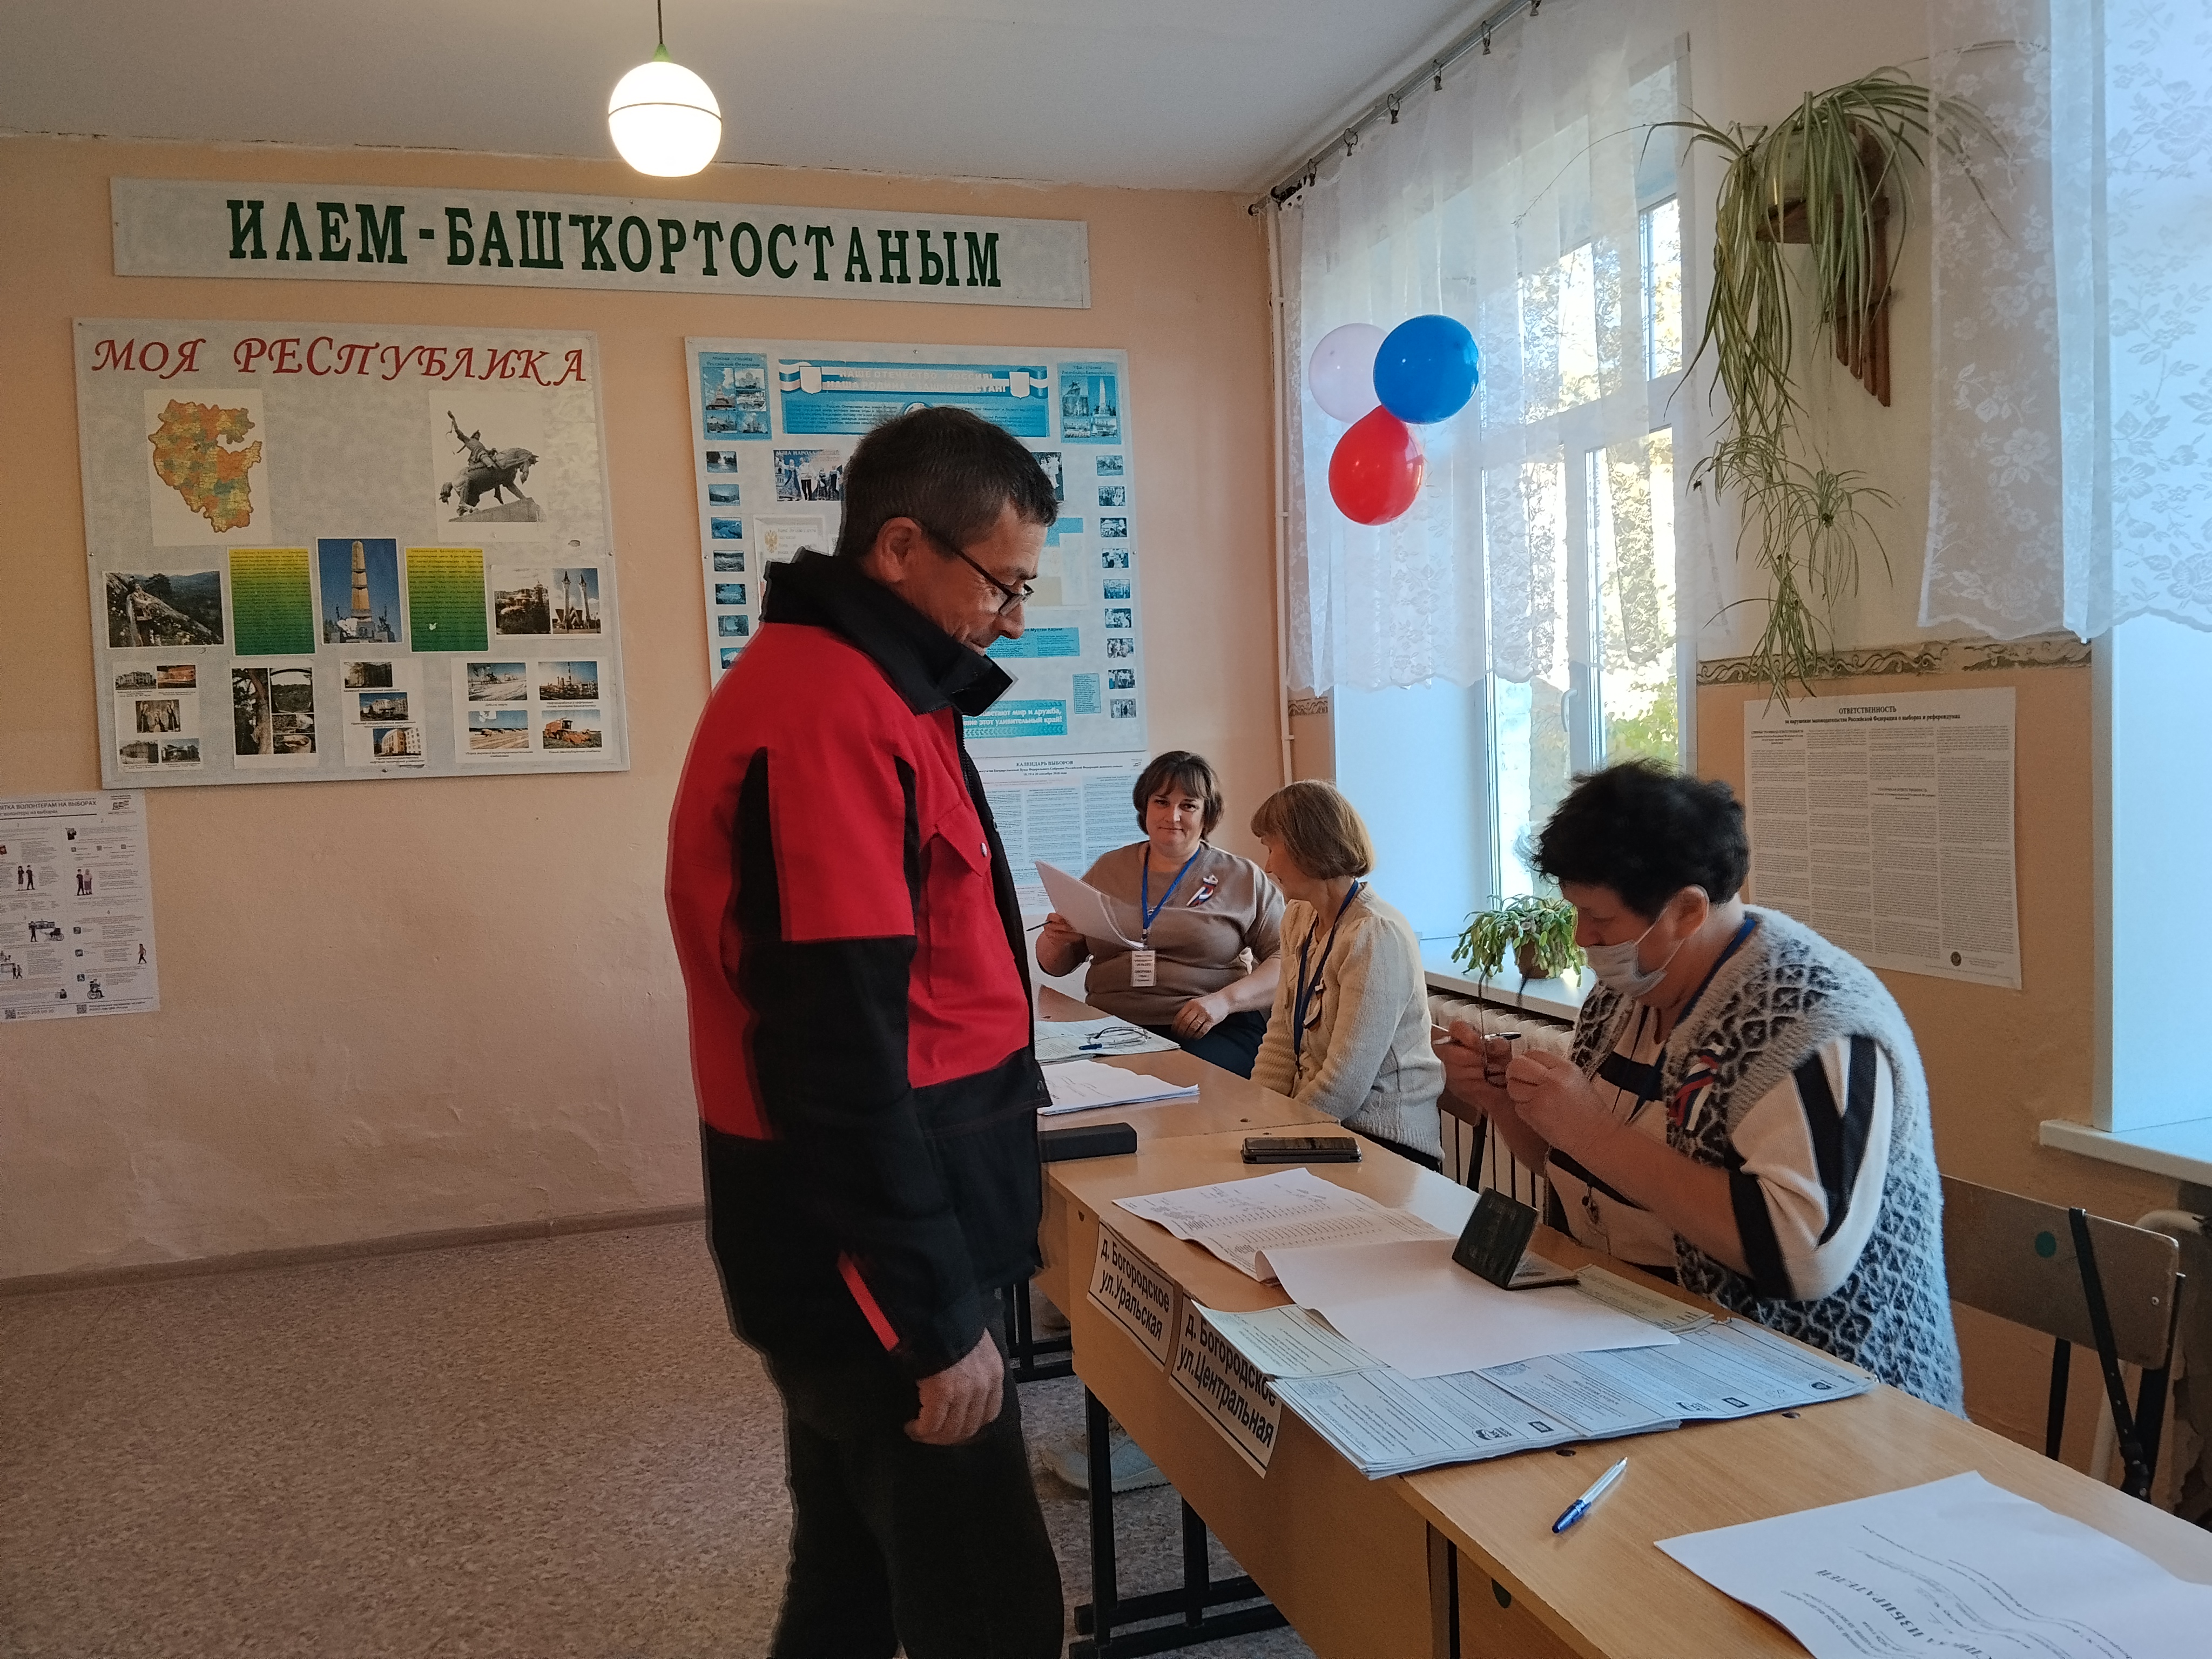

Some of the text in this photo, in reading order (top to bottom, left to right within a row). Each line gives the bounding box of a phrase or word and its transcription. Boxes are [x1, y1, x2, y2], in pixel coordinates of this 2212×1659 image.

[92, 336, 586, 386] МОЯ РЕСПУБЛИКА
[874, 371, 938, 379] ОТЕЧЕСТВО
[826, 380, 859, 390] НАША
[1012, 709, 1027, 717] мир
[1034, 707, 1062, 716] дружба,
[1839, 705, 1897, 714] ОТВЕТСТВЕННОСТЬ
[995, 717, 1043, 726] удивительный
[1044, 716, 1062, 724] край!
[1101, 1239, 1110, 1259] д.
[1111, 1240, 1170, 1313] Богородское
[1185, 1313, 1197, 1341] д.
[1815, 1569, 1925, 1637] ИЗБИРАТЕЛЕЙ
